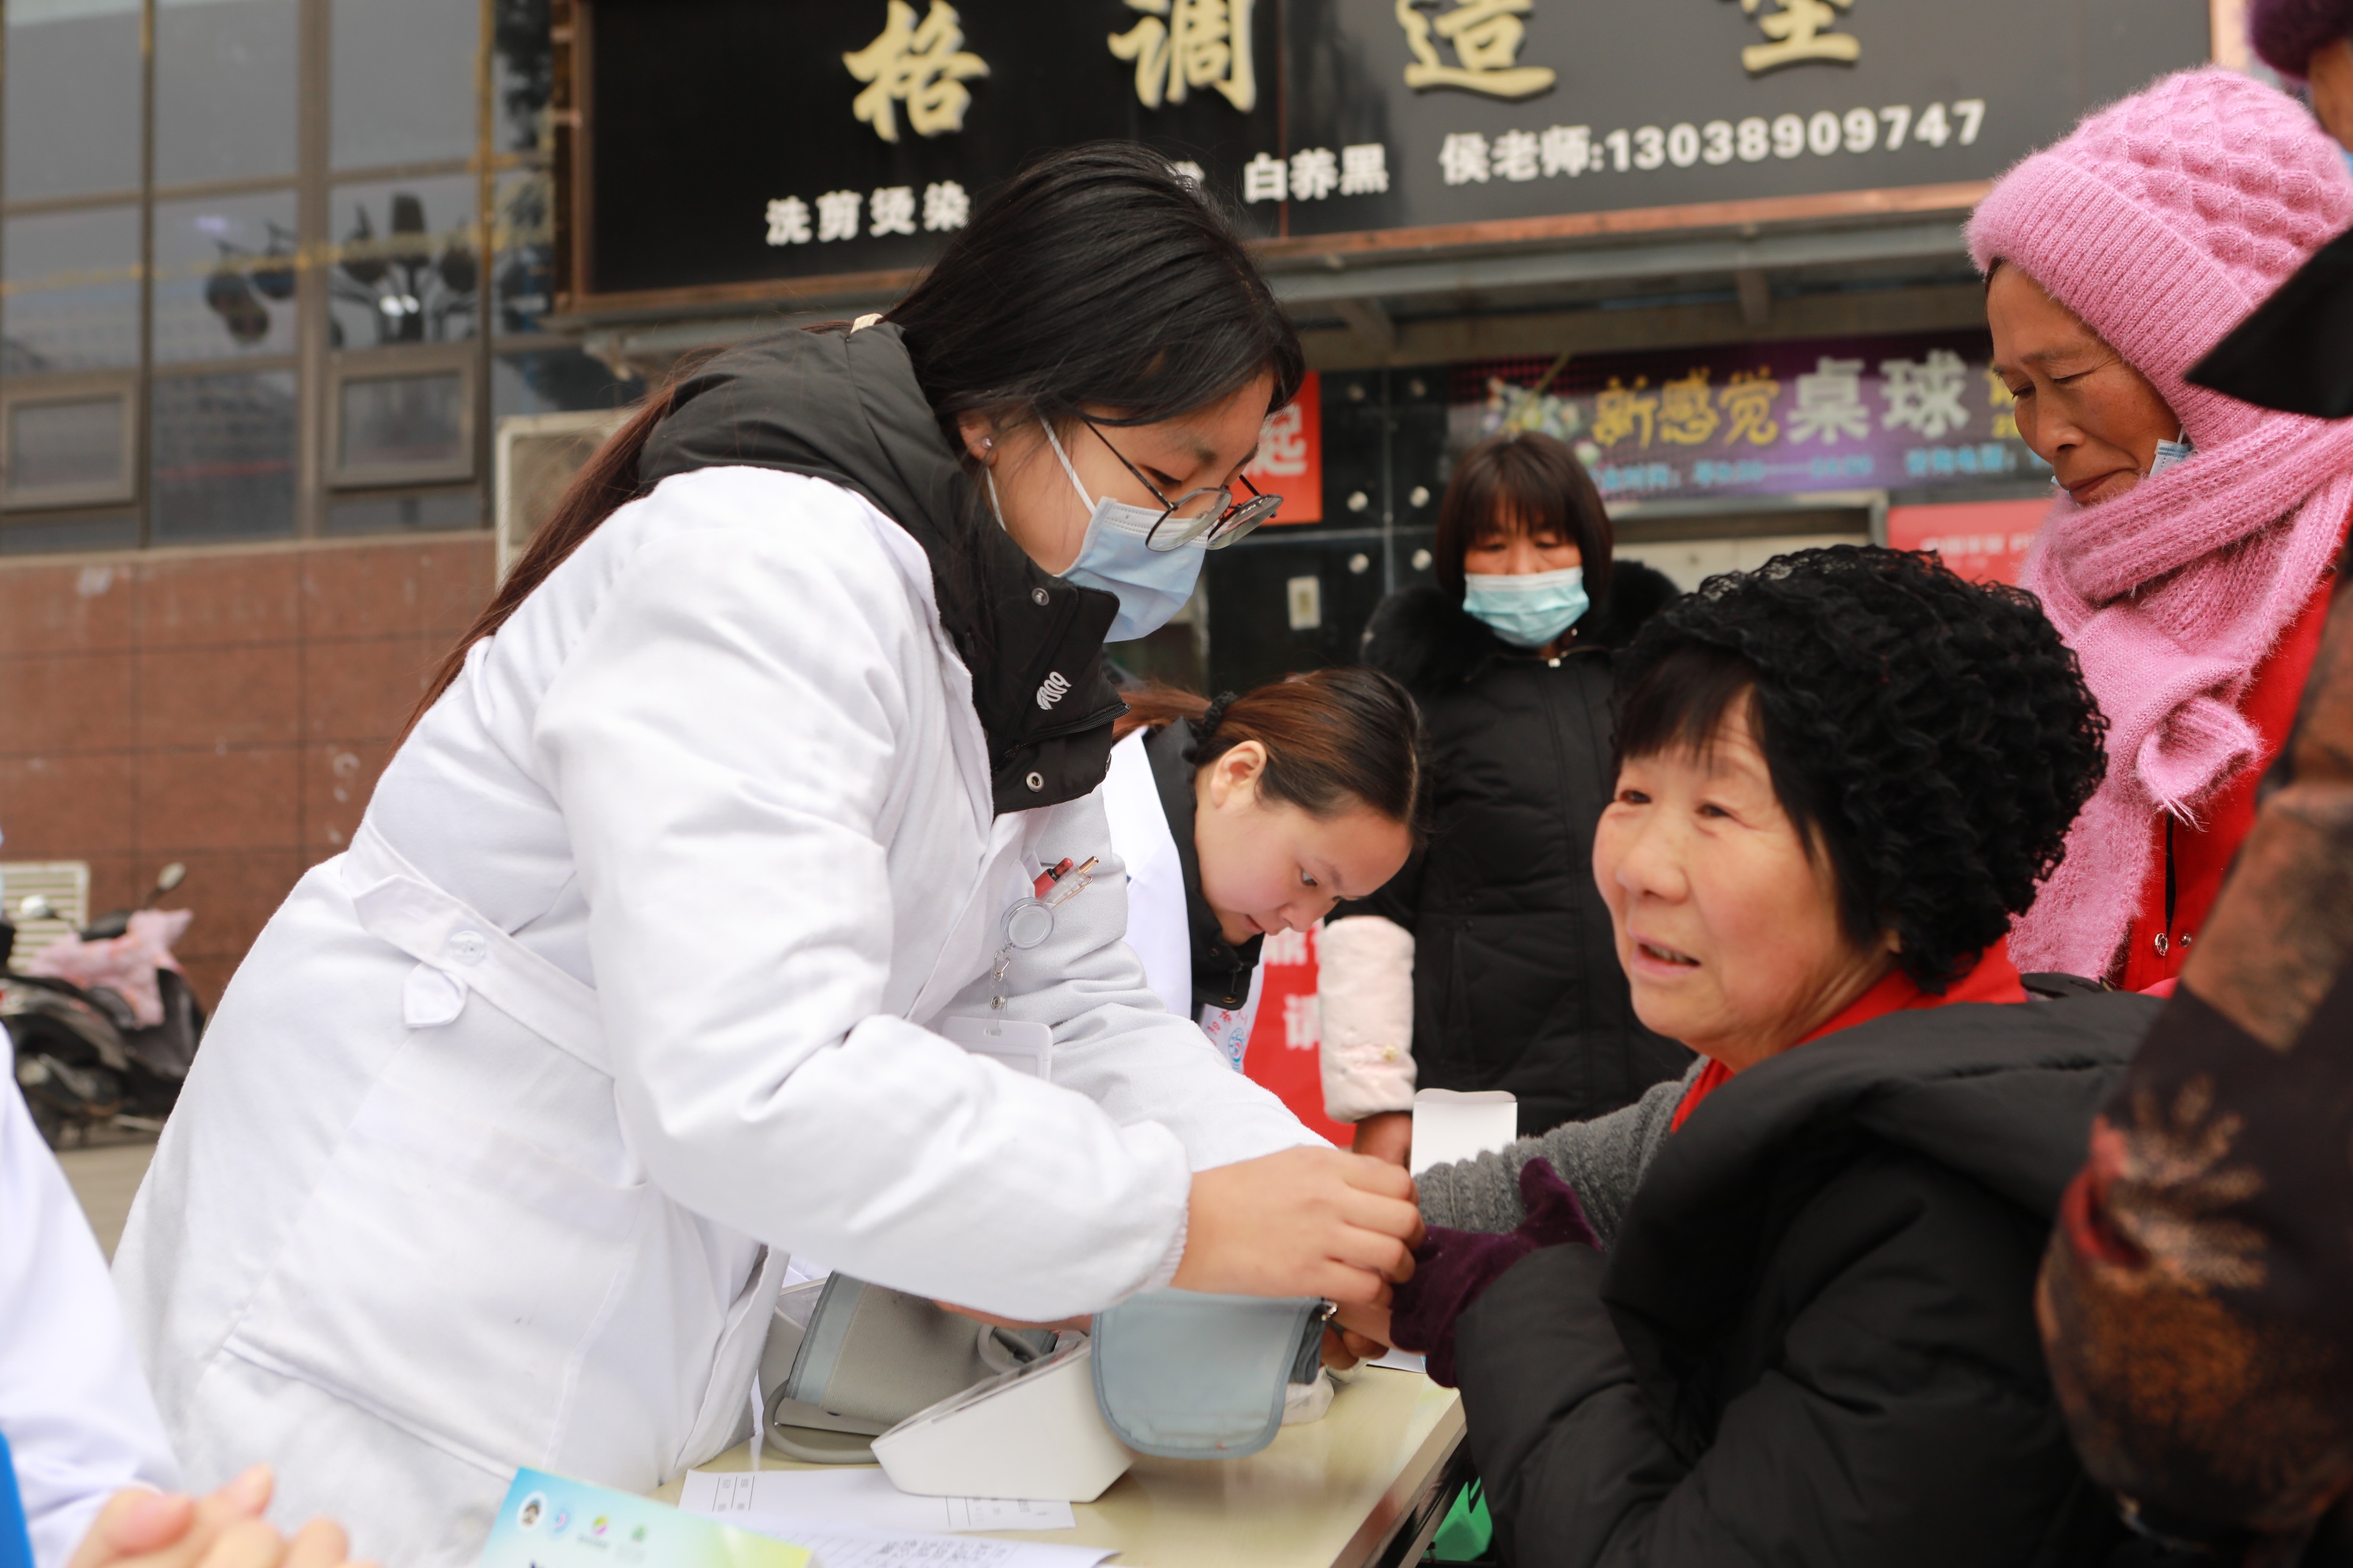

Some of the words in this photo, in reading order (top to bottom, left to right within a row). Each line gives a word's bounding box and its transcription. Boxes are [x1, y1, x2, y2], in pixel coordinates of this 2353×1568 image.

[765, 180, 970, 246] 洗剪烫染
[1244, 143, 1389, 204] 白养黑
